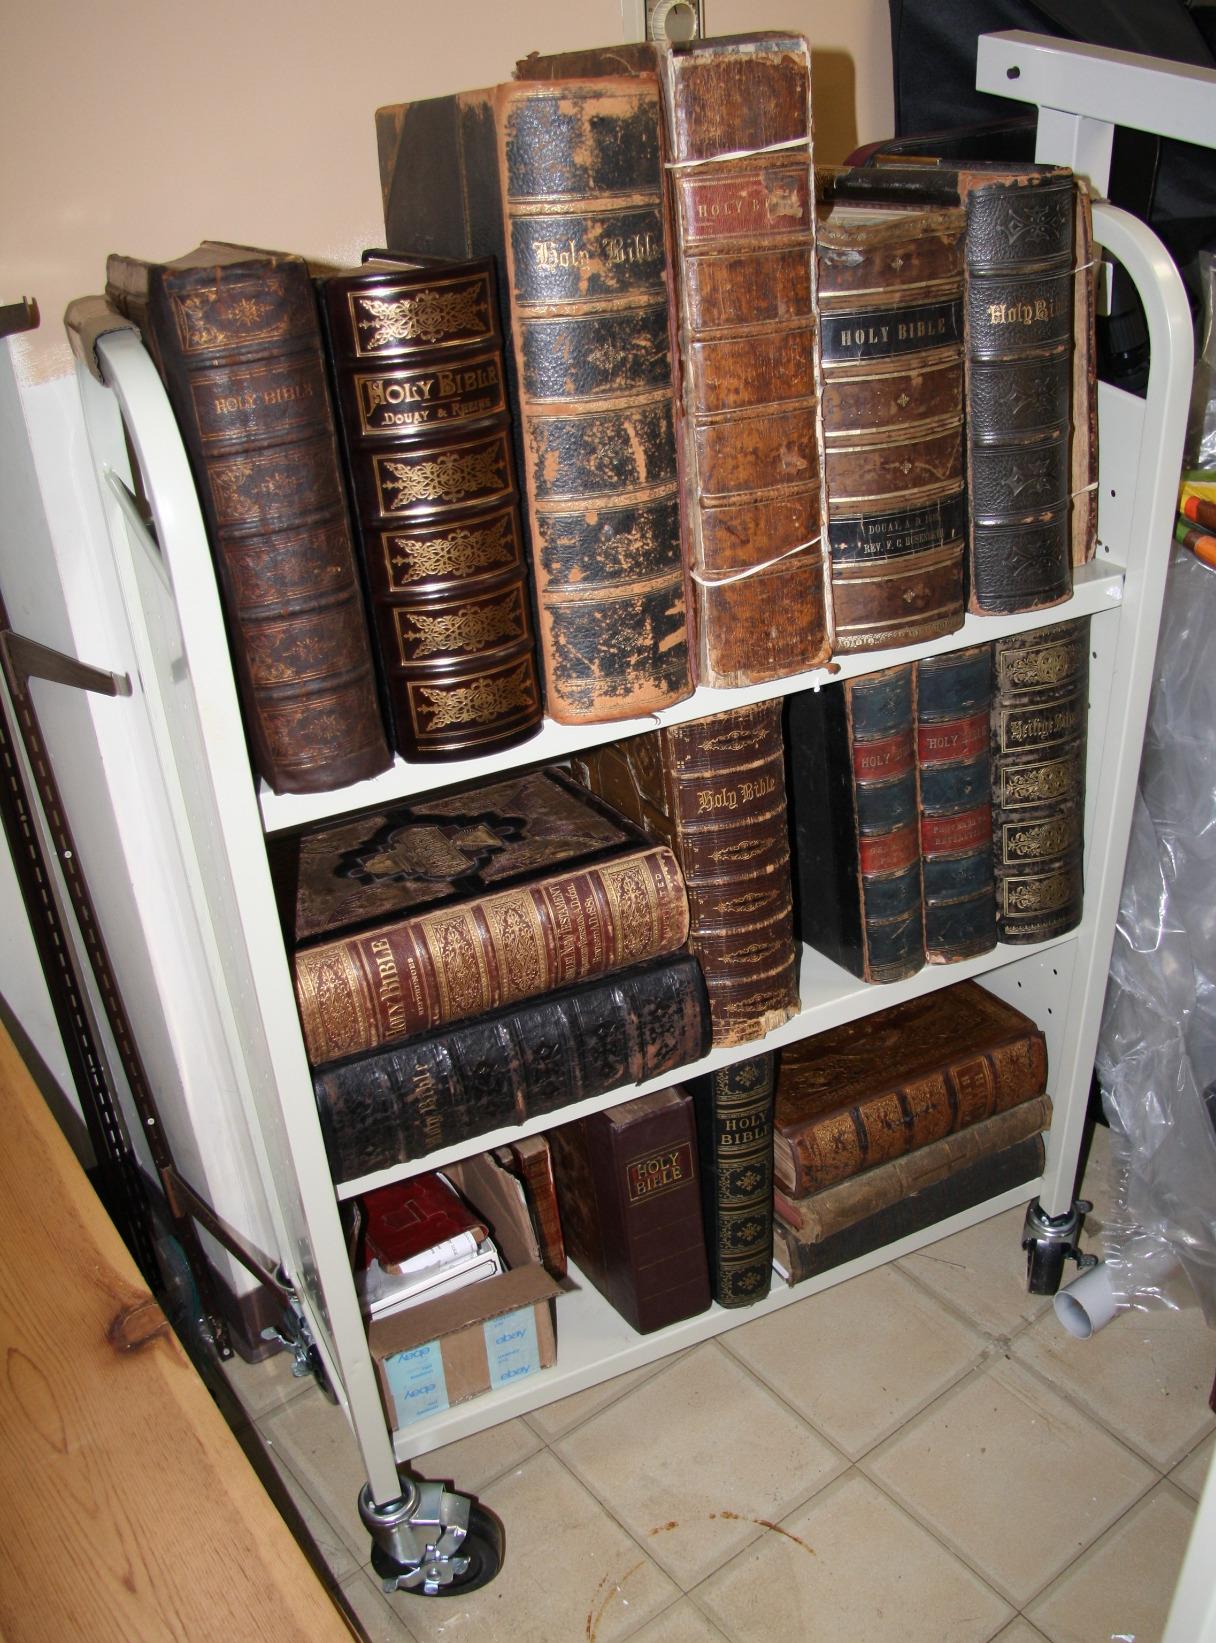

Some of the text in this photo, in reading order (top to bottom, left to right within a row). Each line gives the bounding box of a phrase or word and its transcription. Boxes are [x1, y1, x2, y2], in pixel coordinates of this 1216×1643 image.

[699, 200, 742, 218] HOLY
[532, 240, 590, 272] Holy
[989, 303, 1032, 325] Holy
[841, 317, 945, 346] HOLY BIBLE
[366, 366, 499, 417] HOLY BIBLE
[214, 392, 257, 414] HOLY
[381, 411, 430, 426] DOUAY
[437, 408, 447, 417] &
[926, 735, 959, 750] HOLY
[861, 753, 890, 768] HOLY
[697, 775, 776, 814] Holy Bible
[371, 938, 401, 1002] BIBLE
[726, 1111, 767, 1131] HOLY
[638, 1152, 679, 1179] HOLY
[637, 1166, 682, 1195] BIBLE
[496, 1328, 527, 1344] ebay
[398, 1347, 430, 1363] ebay
[501, 1364, 531, 1381] ebay
[404, 1384, 436, 1400] ebay
